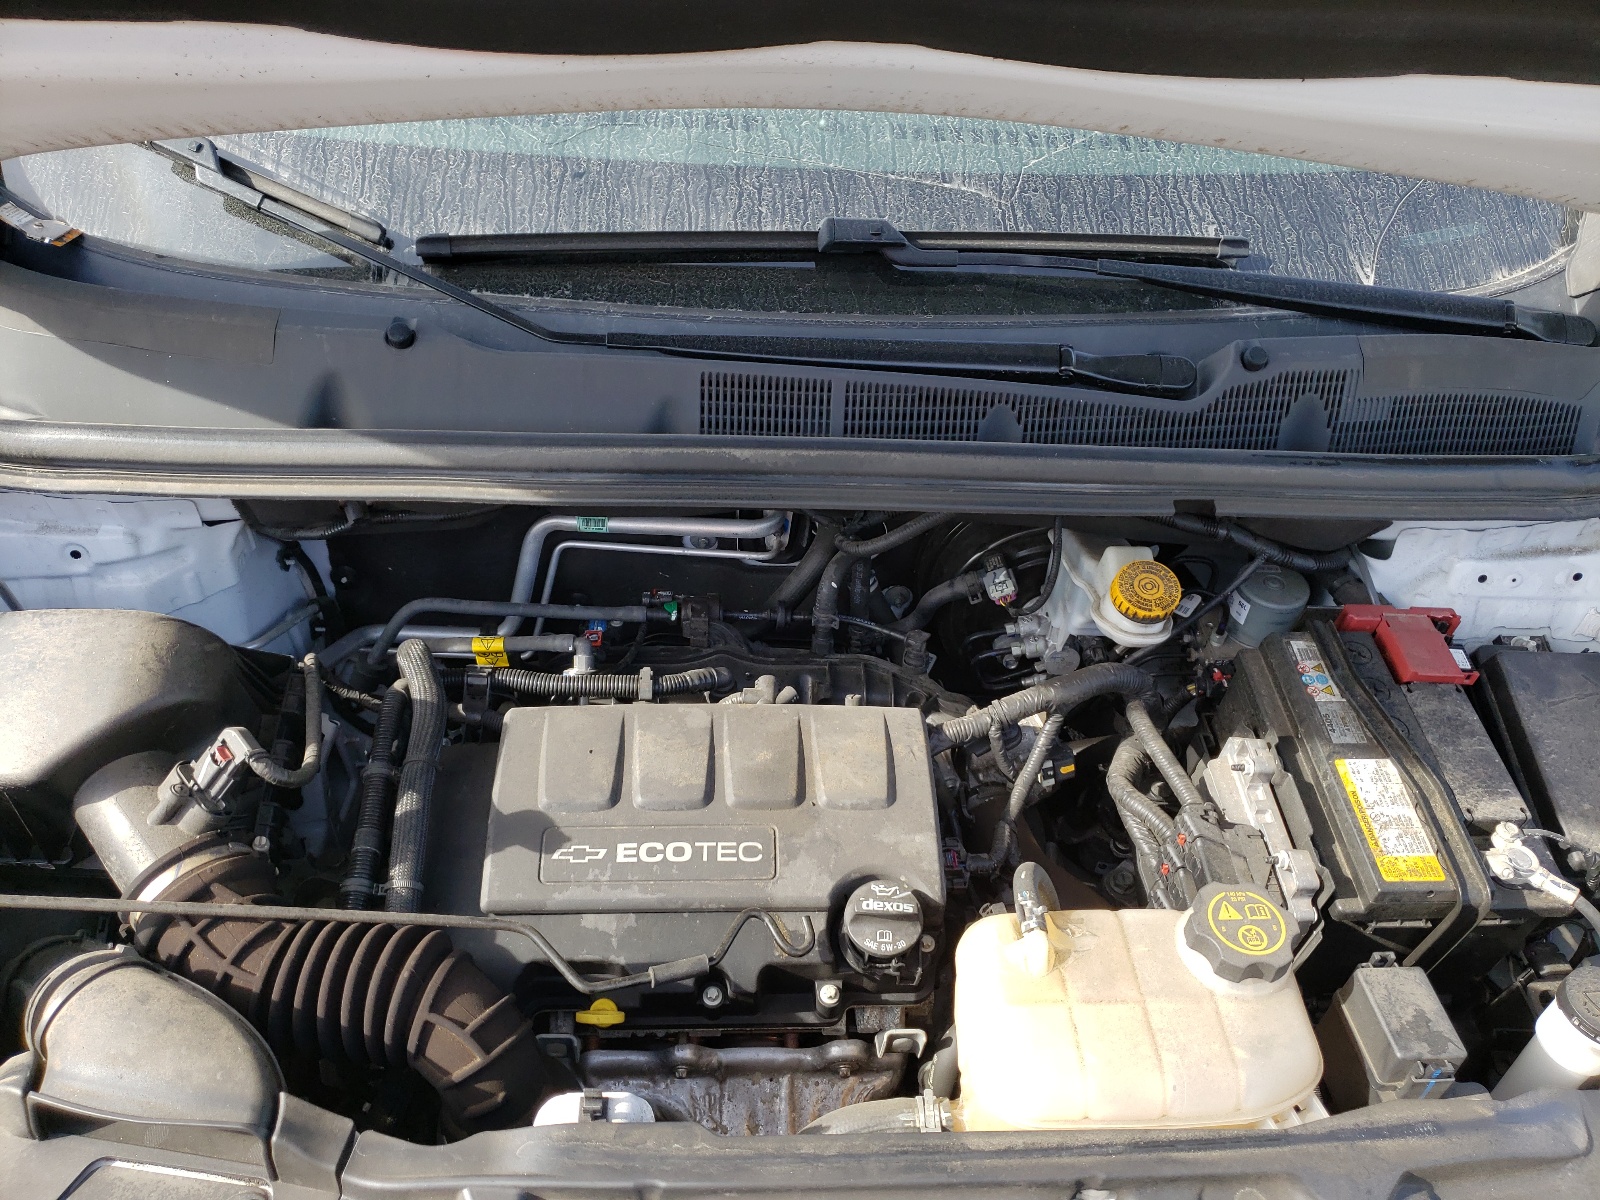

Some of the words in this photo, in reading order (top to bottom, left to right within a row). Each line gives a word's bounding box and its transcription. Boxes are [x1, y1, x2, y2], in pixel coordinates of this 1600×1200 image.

[615, 841, 764, 864] ECOTEC
[862, 898, 915, 913] dexos
[863, 939, 879, 950] SAE
[880, 940, 907, 952] 5W-30
